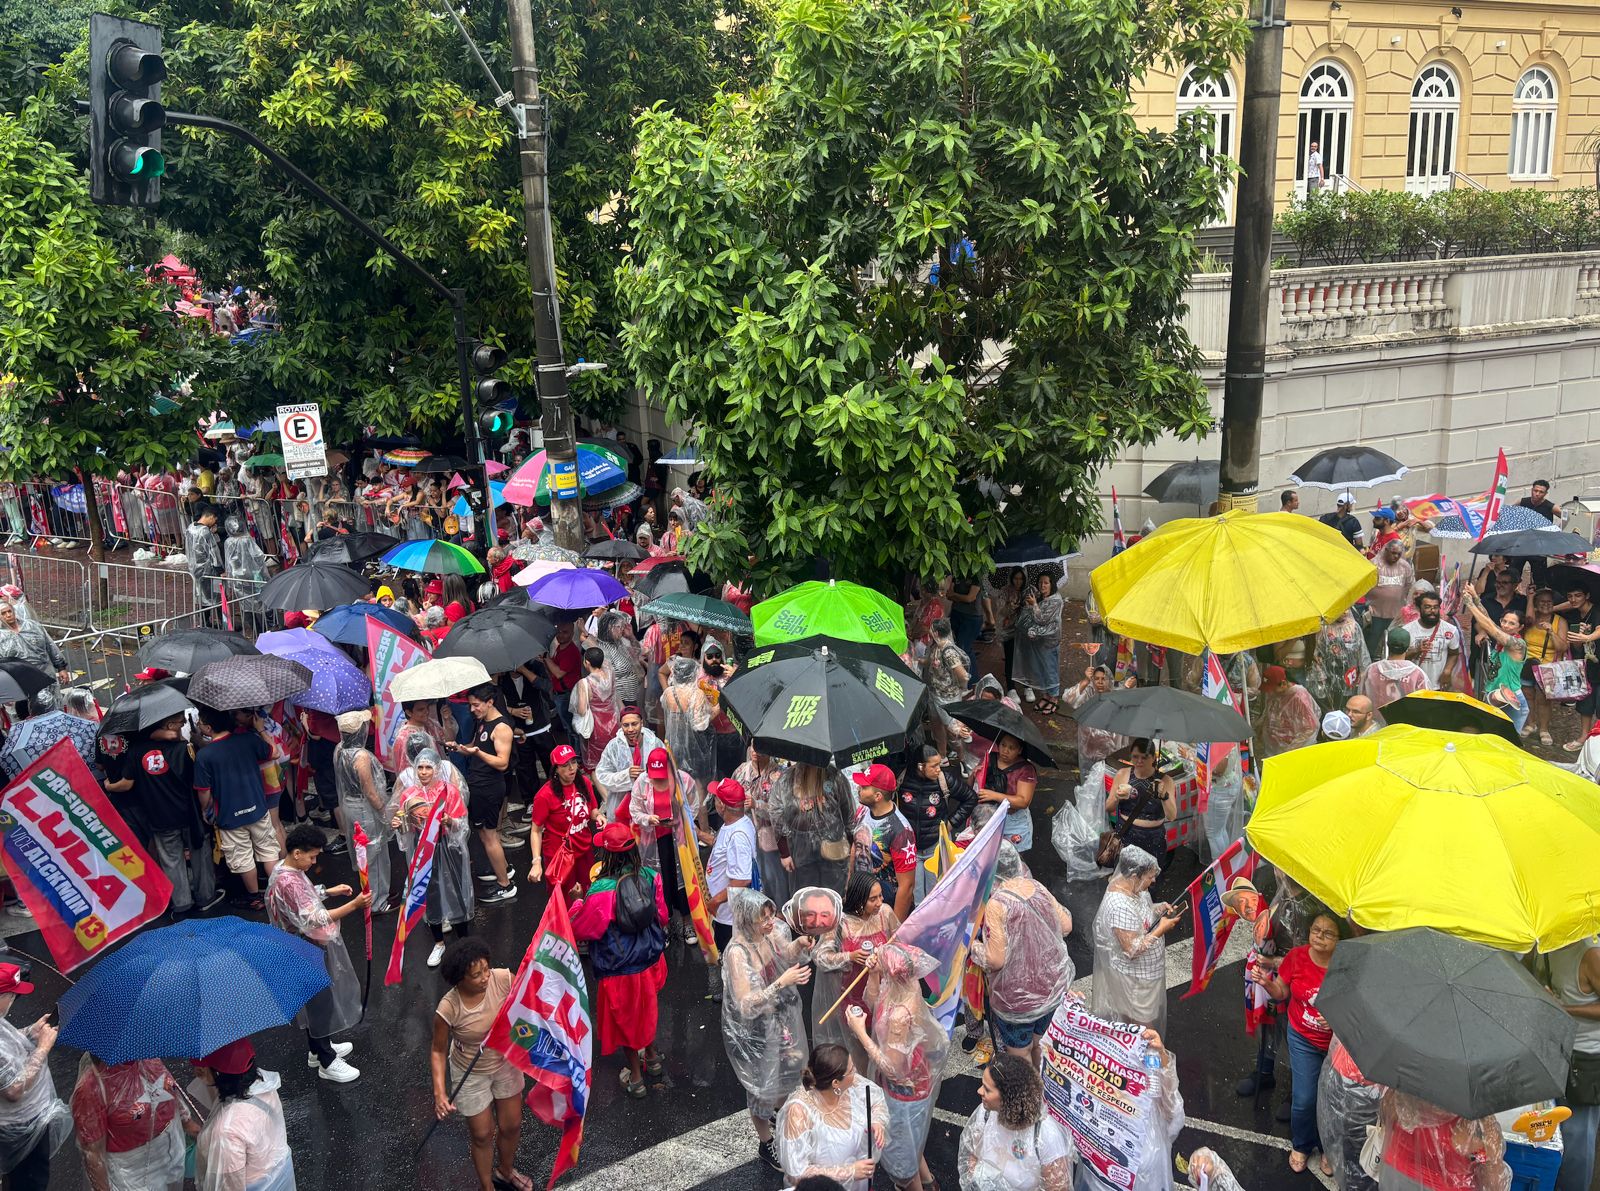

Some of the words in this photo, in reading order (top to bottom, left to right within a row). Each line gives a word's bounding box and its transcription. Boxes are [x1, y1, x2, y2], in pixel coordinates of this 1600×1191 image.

[279, 405, 316, 414] ROTATIVO
[293, 418, 308, 438] E
[778, 609, 808, 625] Sali
[861, 611, 883, 626] Sali
[786, 696, 822, 713] TUTS
[782, 709, 817, 731] TUTS
[146, 754, 165, 771] 13
[852, 751, 882, 764] SALINAS
[38, 768, 120, 849] PRESIDENTE
[7, 786, 128, 911] LULA
[11, 827, 36, 852] VICE
[24, 844, 91, 916] ALCKMIN
[78, 916, 106, 940] 13
[1079, 1015, 1137, 1049] DIREITO!
[1049, 1025, 1094, 1057] DEMISSÃO
[1095, 1052, 1110, 1071] EM
[1110, 1064, 1147, 1086] MASSA
[1057, 1043, 1072, 1056] NO
[1074, 1050, 1090, 1068] DIA
[1089, 1061, 1123, 1088] 02/10
[1060, 1056, 1085, 1078] DIGA
[1063, 1068, 1085, 1086] FALTA
[1085, 1084, 1095, 1092] DE
[1096, 1088, 1137, 1115] RESPEITO!
